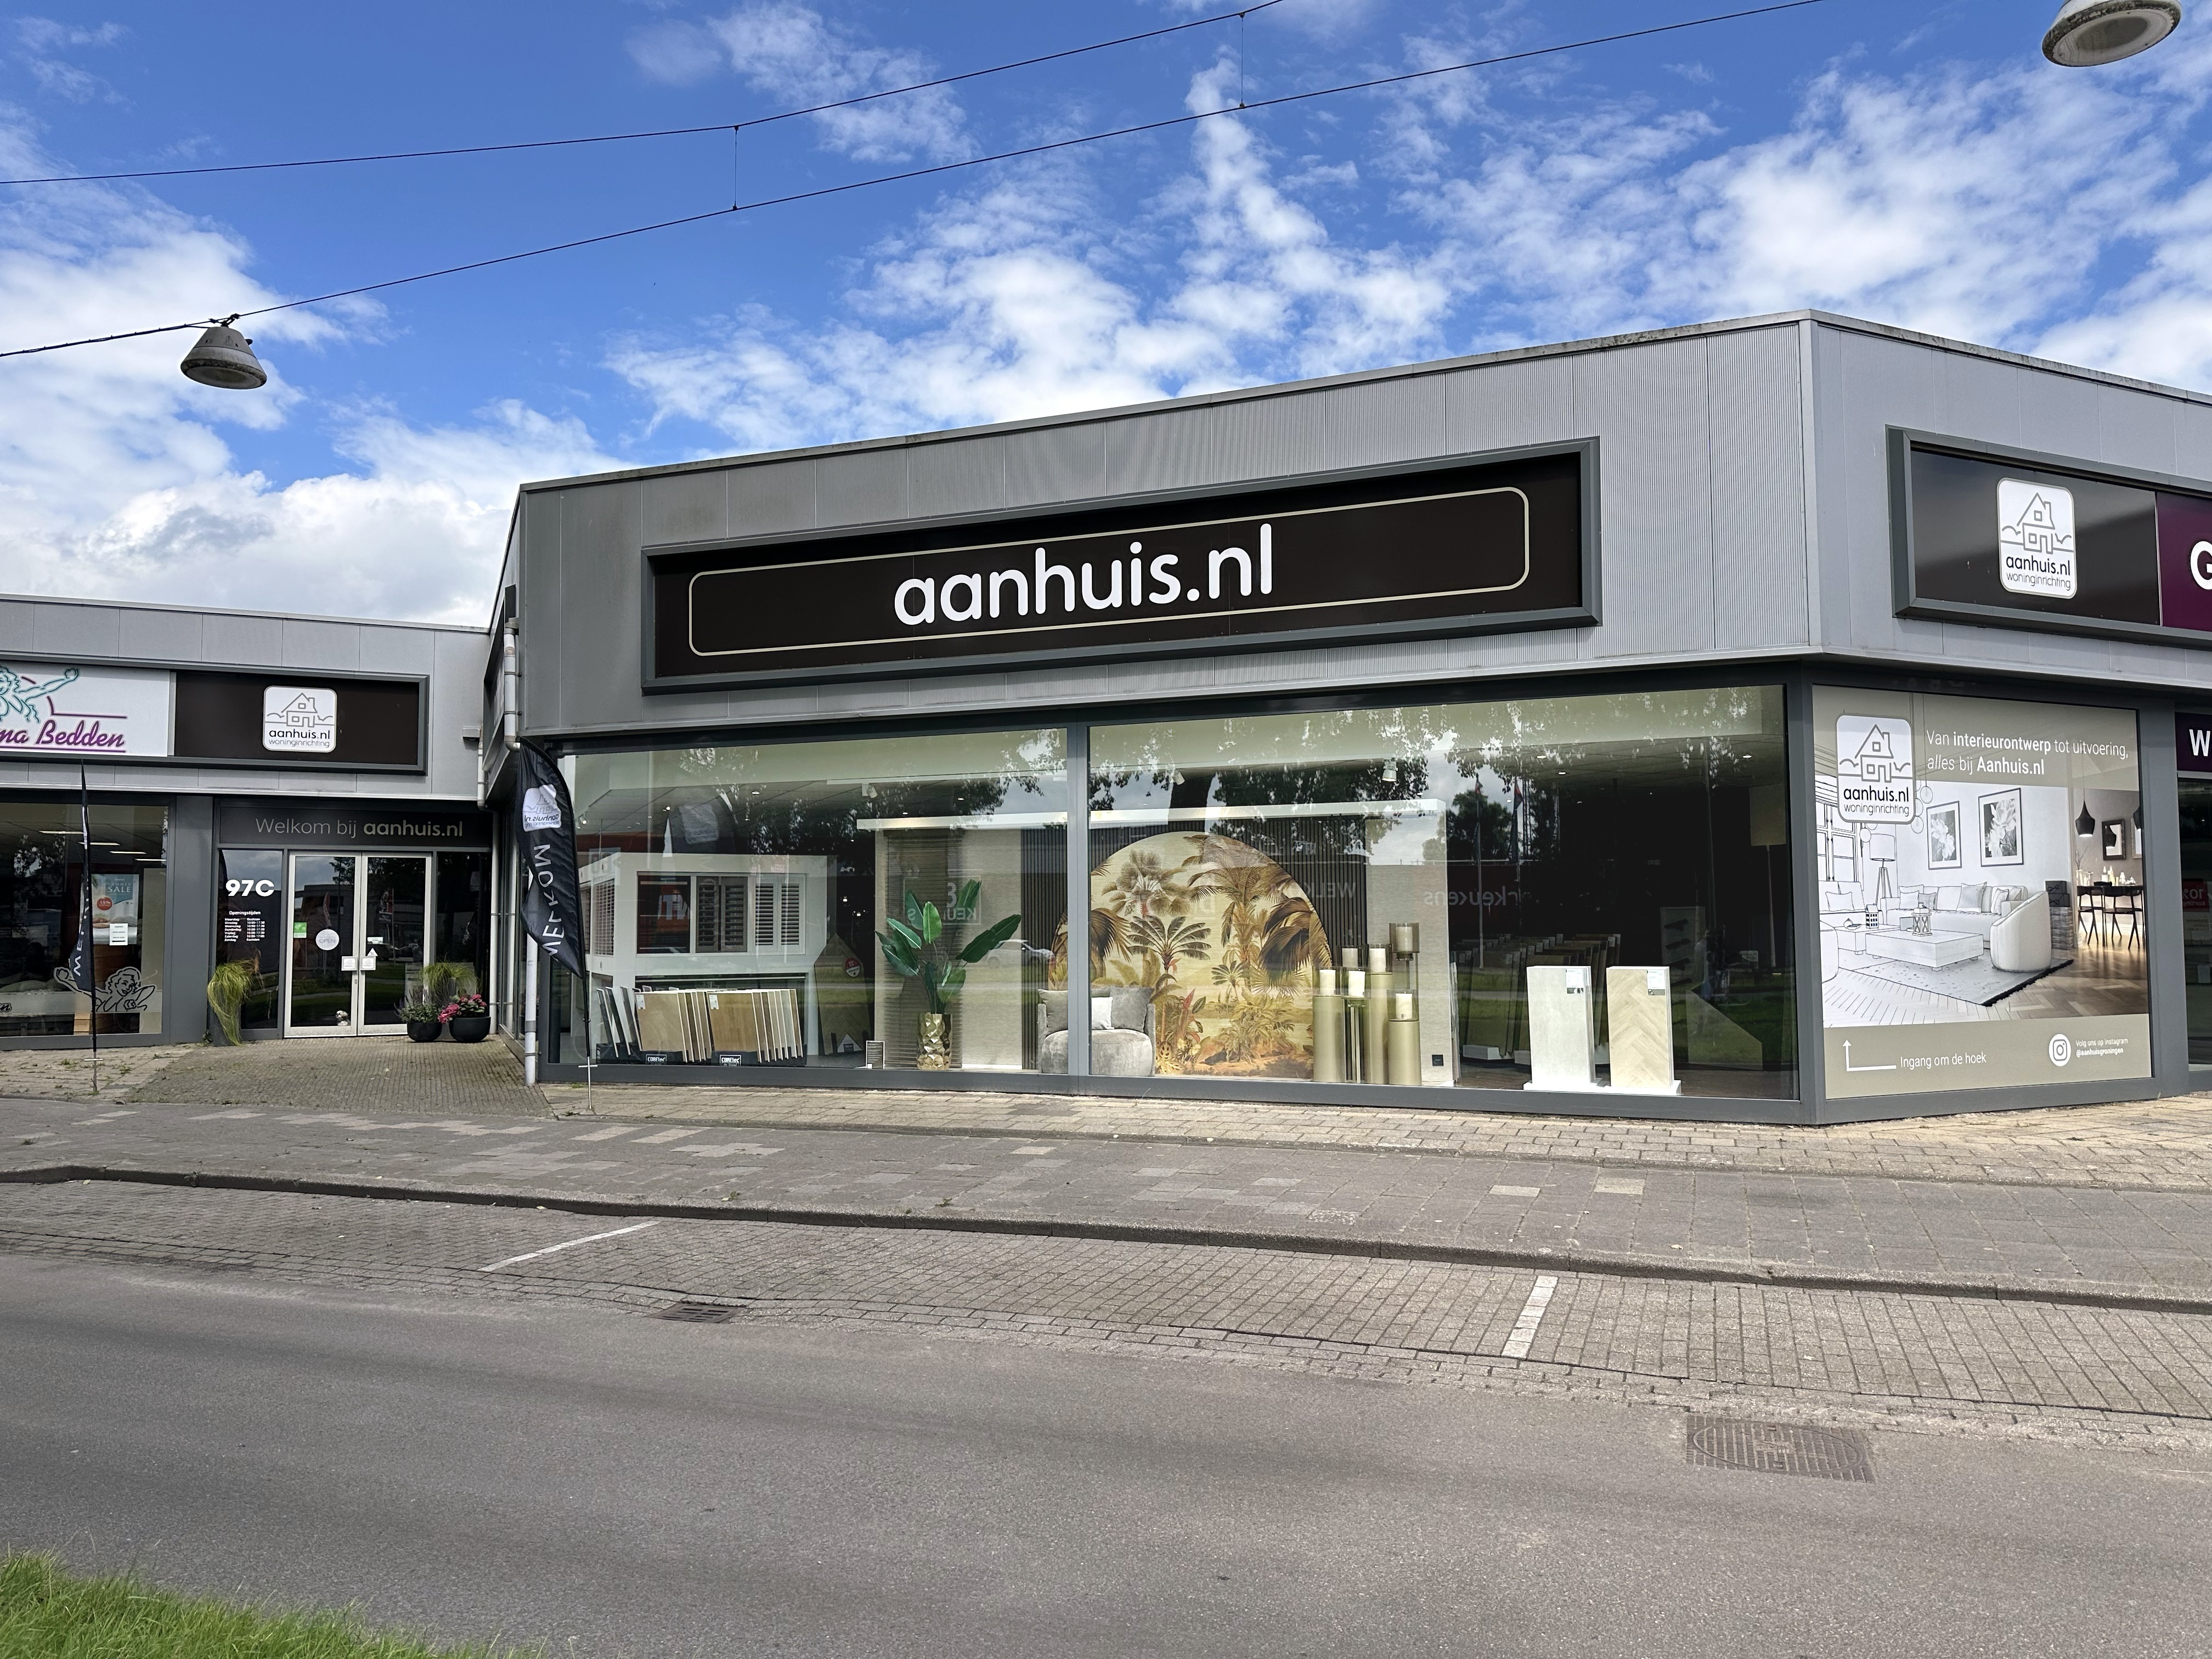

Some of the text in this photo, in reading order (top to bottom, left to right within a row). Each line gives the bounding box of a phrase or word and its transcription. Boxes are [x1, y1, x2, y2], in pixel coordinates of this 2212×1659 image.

[894, 523, 1272, 625] aanhuis.nl
[2006, 555, 2070, 575] aanhuis.nl
[2006, 572, 2071, 591] woninginrichting
[35, 719, 125, 747] Bedden
[269, 728, 330, 740] aanhuis.nl
[269, 739, 330, 748] woninginrichting
[1926, 730, 2129, 759] Van interieurontwerp tot uitvoering,
[1927, 754, 2045, 775] alles bij Aanhuis.nl
[1843, 785, 1909, 802] aanhuis.nl
[1843, 803, 1910, 817] woninginrichting
[255, 818, 463, 839] Welkom bij aanhuis.nl
[225, 879, 274, 896] 97C
[2075, 1040, 2087, 1048] Volg
[2076, 1047, 2124, 1058] @aanhuisgroningen
[1900, 1051, 1987, 1070] Ingang om de hoek
